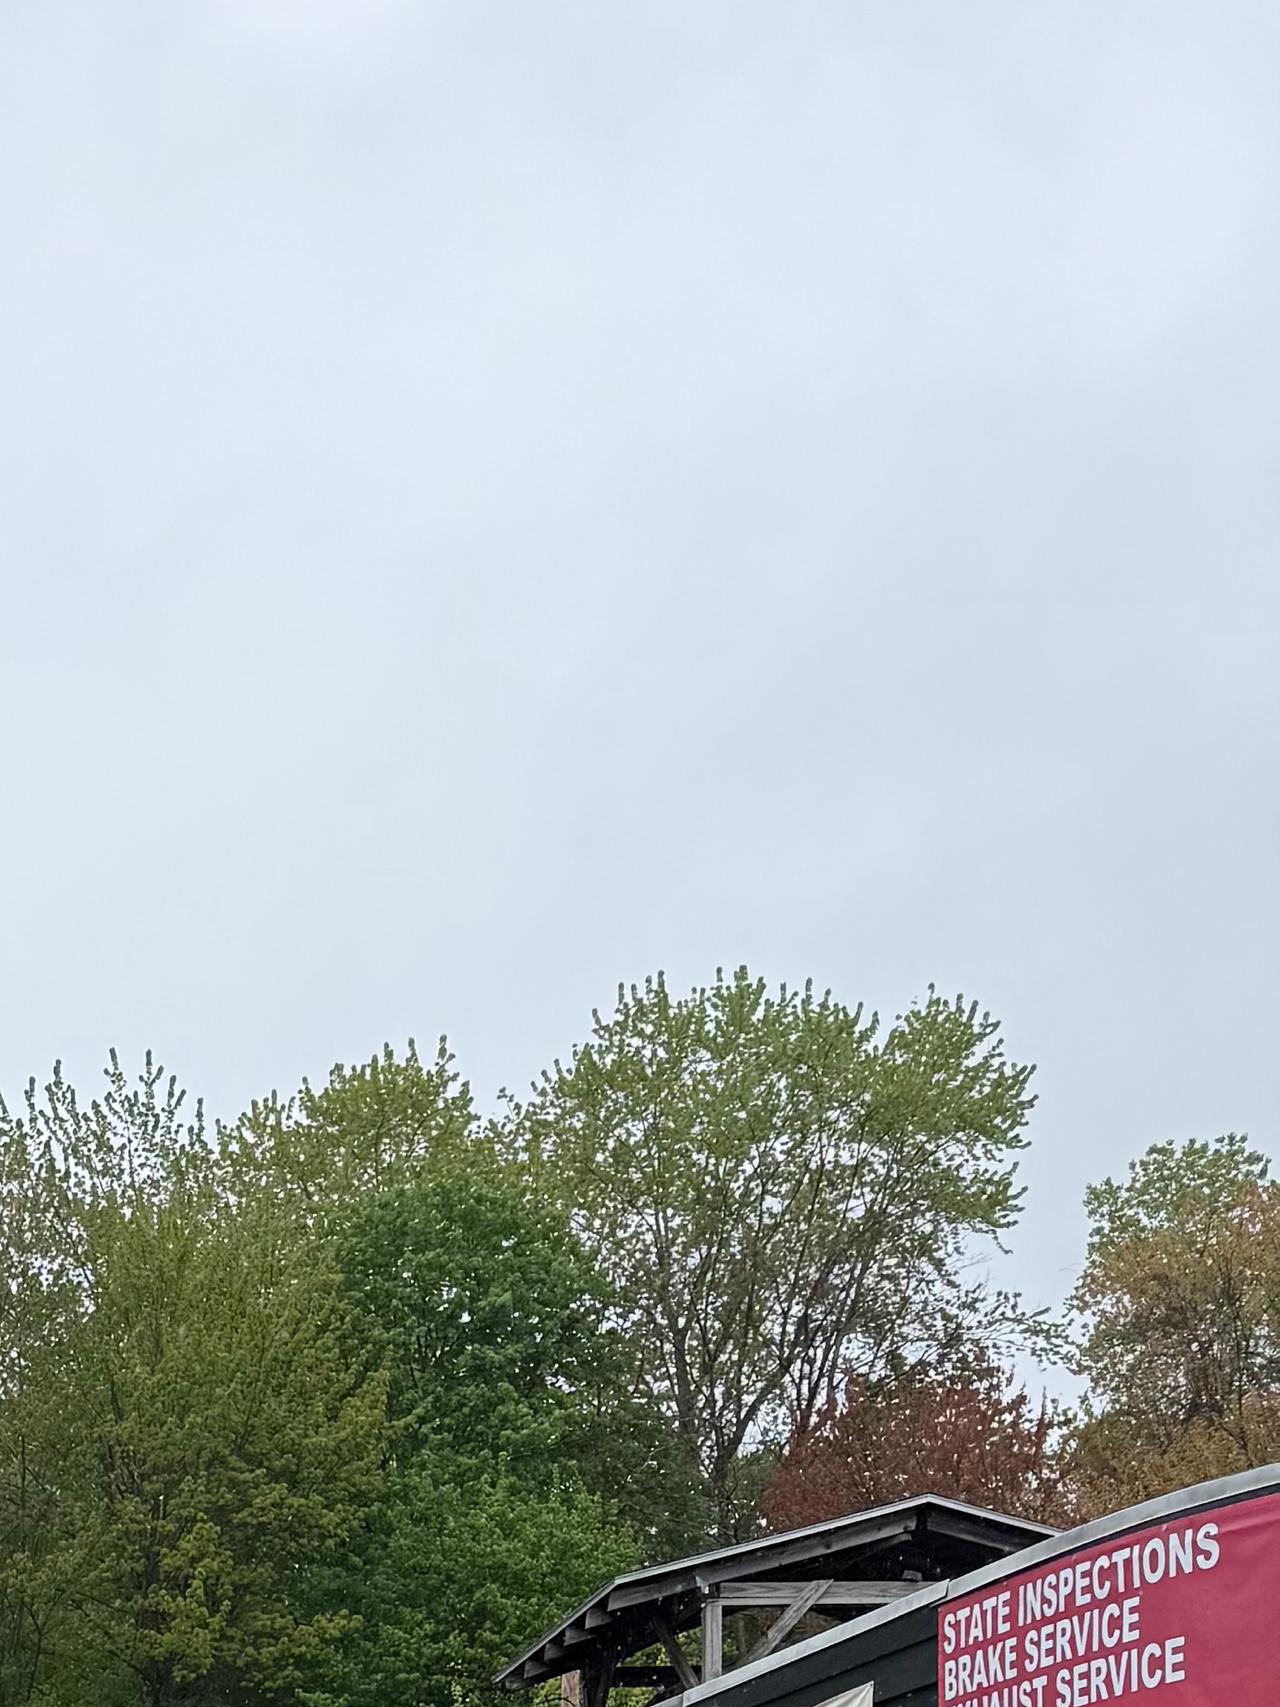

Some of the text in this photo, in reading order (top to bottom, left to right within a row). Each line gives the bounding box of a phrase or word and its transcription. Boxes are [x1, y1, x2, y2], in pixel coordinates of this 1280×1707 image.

[944, 1522, 1220, 1654] STATE INSPECTIONS
[944, 1596, 1140, 1701] BRAKE SERVICE
